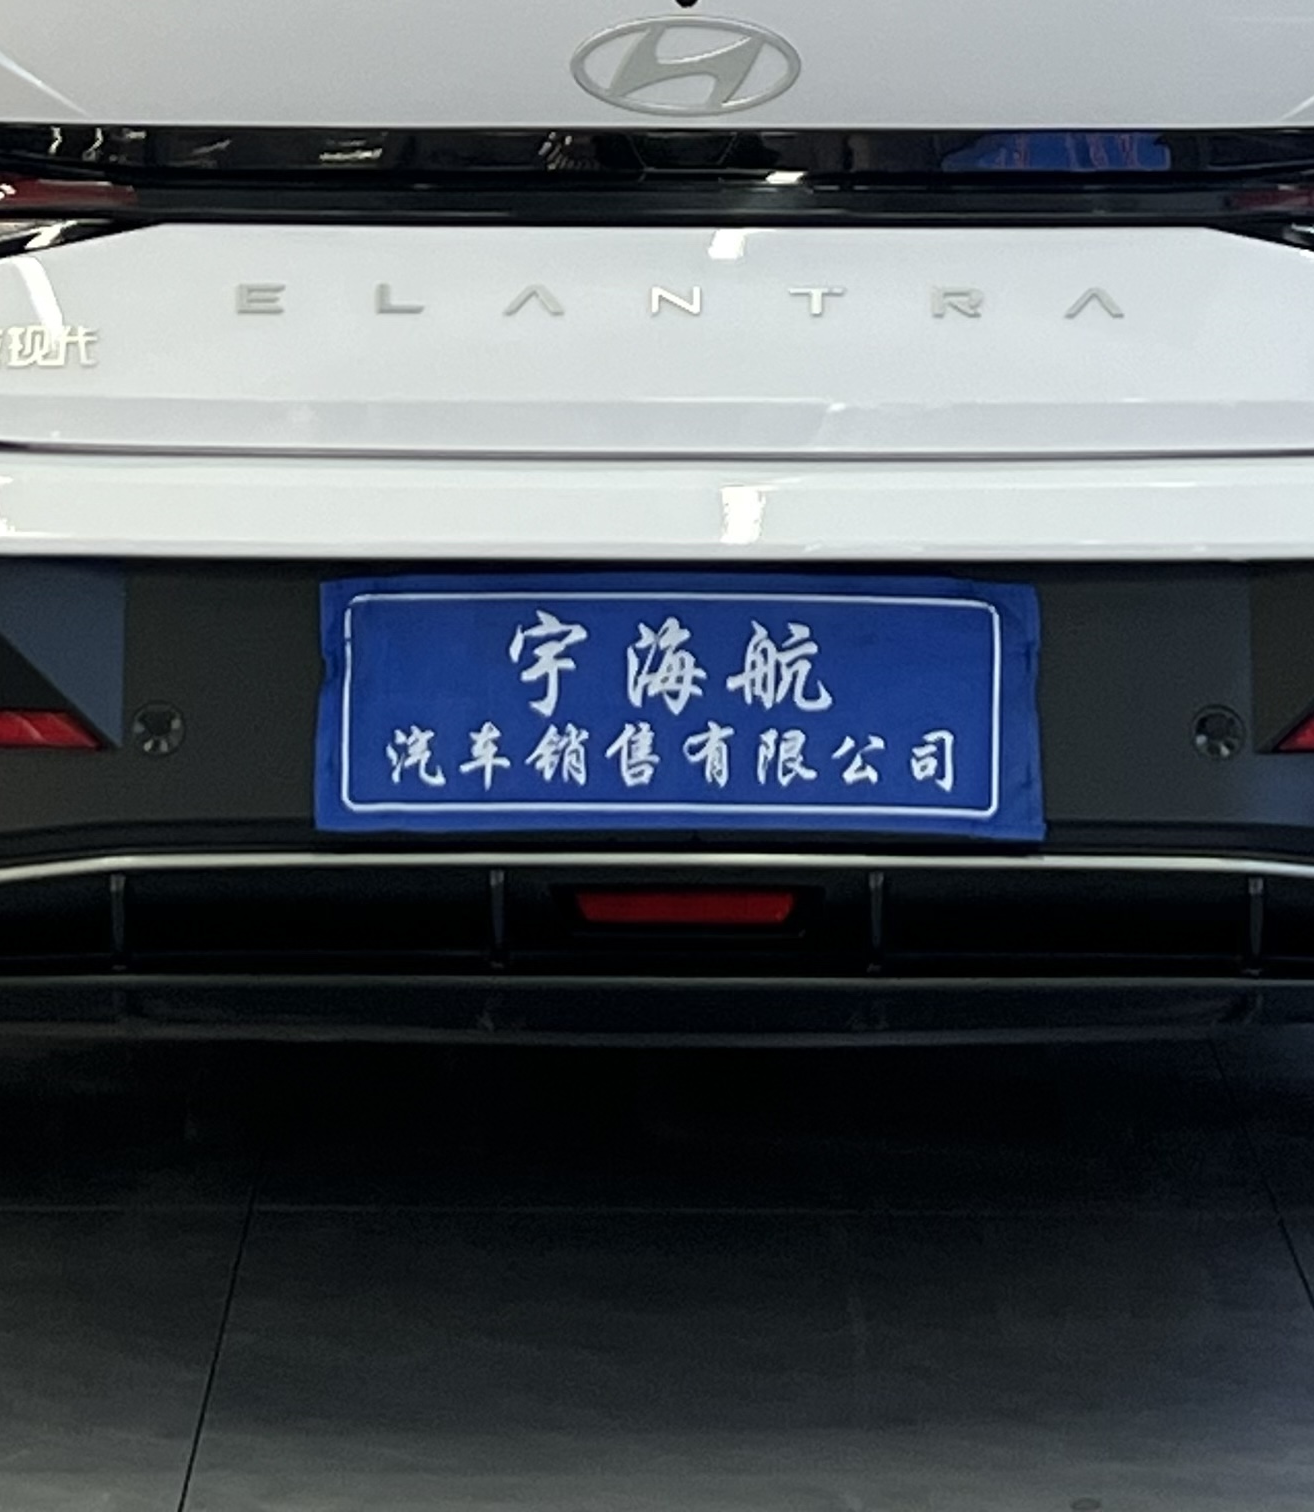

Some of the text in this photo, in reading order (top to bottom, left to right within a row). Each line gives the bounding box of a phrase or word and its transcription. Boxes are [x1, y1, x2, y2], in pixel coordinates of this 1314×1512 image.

[235, 284, 1126, 320] ELANTRA
[508, 608, 834, 718] 宇海航
[385, 718, 958, 793] 汽车销售有限公司
